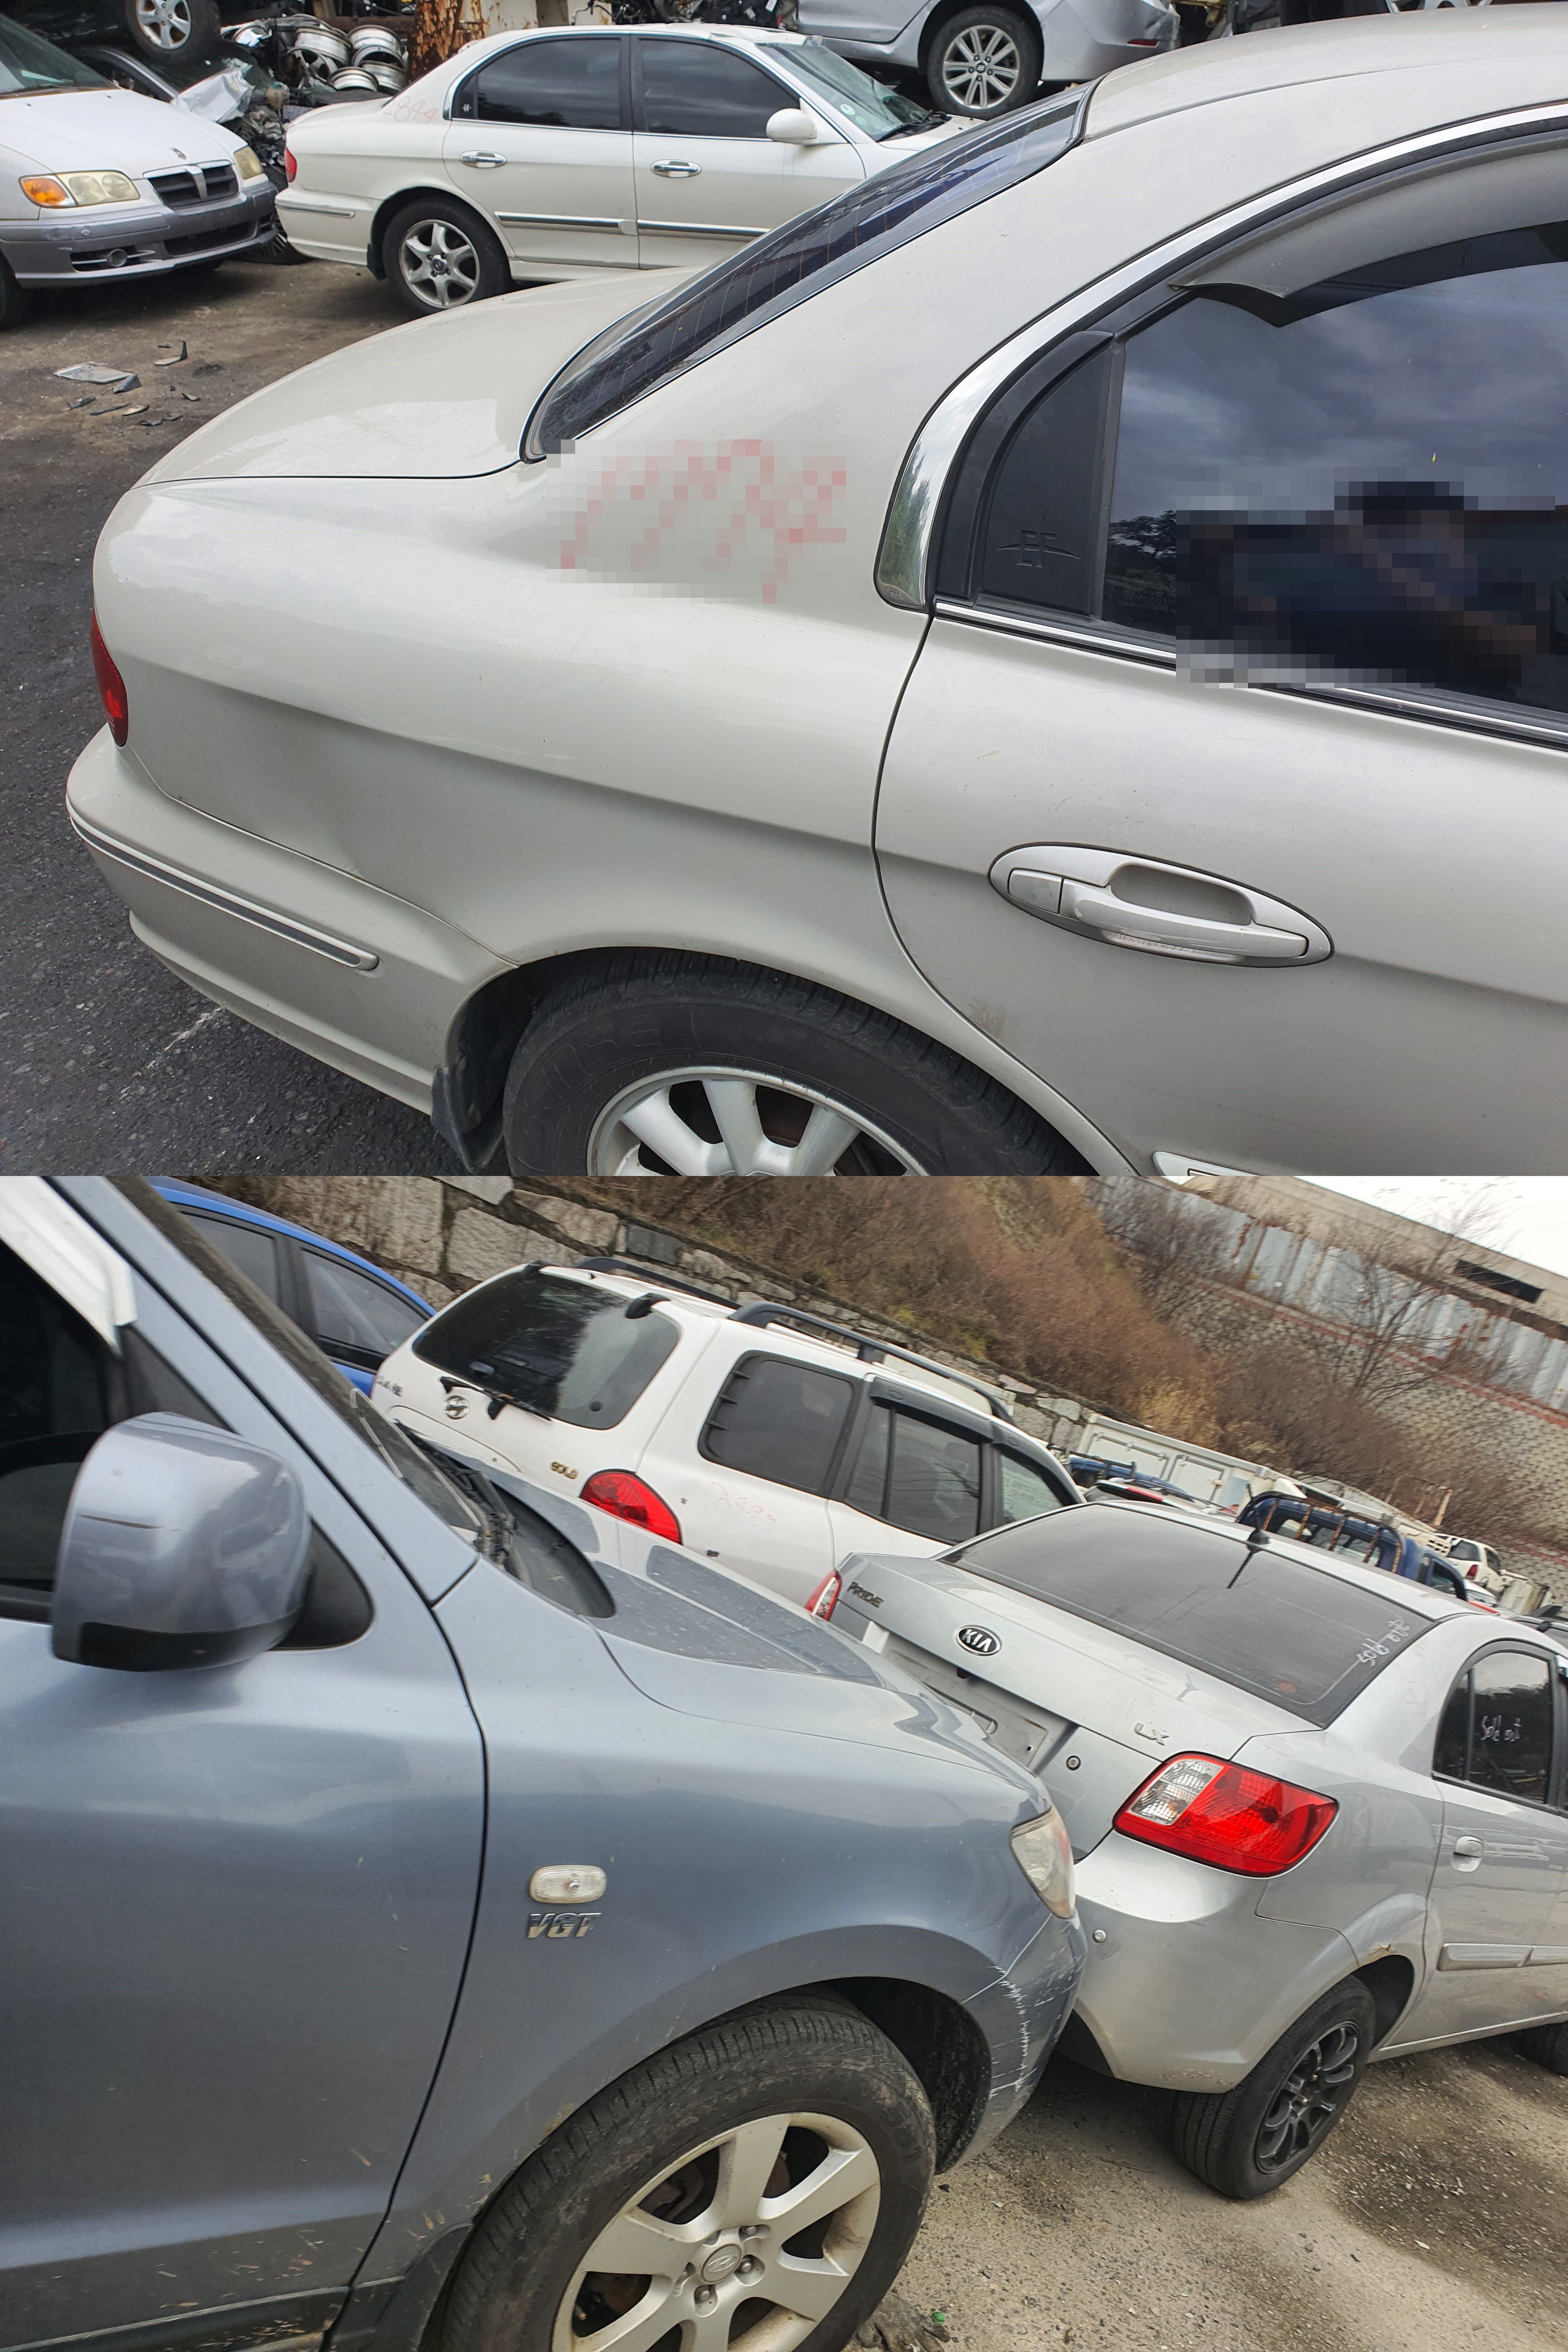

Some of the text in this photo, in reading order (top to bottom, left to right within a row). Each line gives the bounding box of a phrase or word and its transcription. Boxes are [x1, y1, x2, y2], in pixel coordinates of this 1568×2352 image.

[551, 1461, 579, 1480] GOLD
[847, 1581, 885, 1608] PRIDE
[961, 1628, 993, 1652] KIA
[1134, 1722, 1170, 1746] LX
[527, 1912, 602, 1938] VGT
